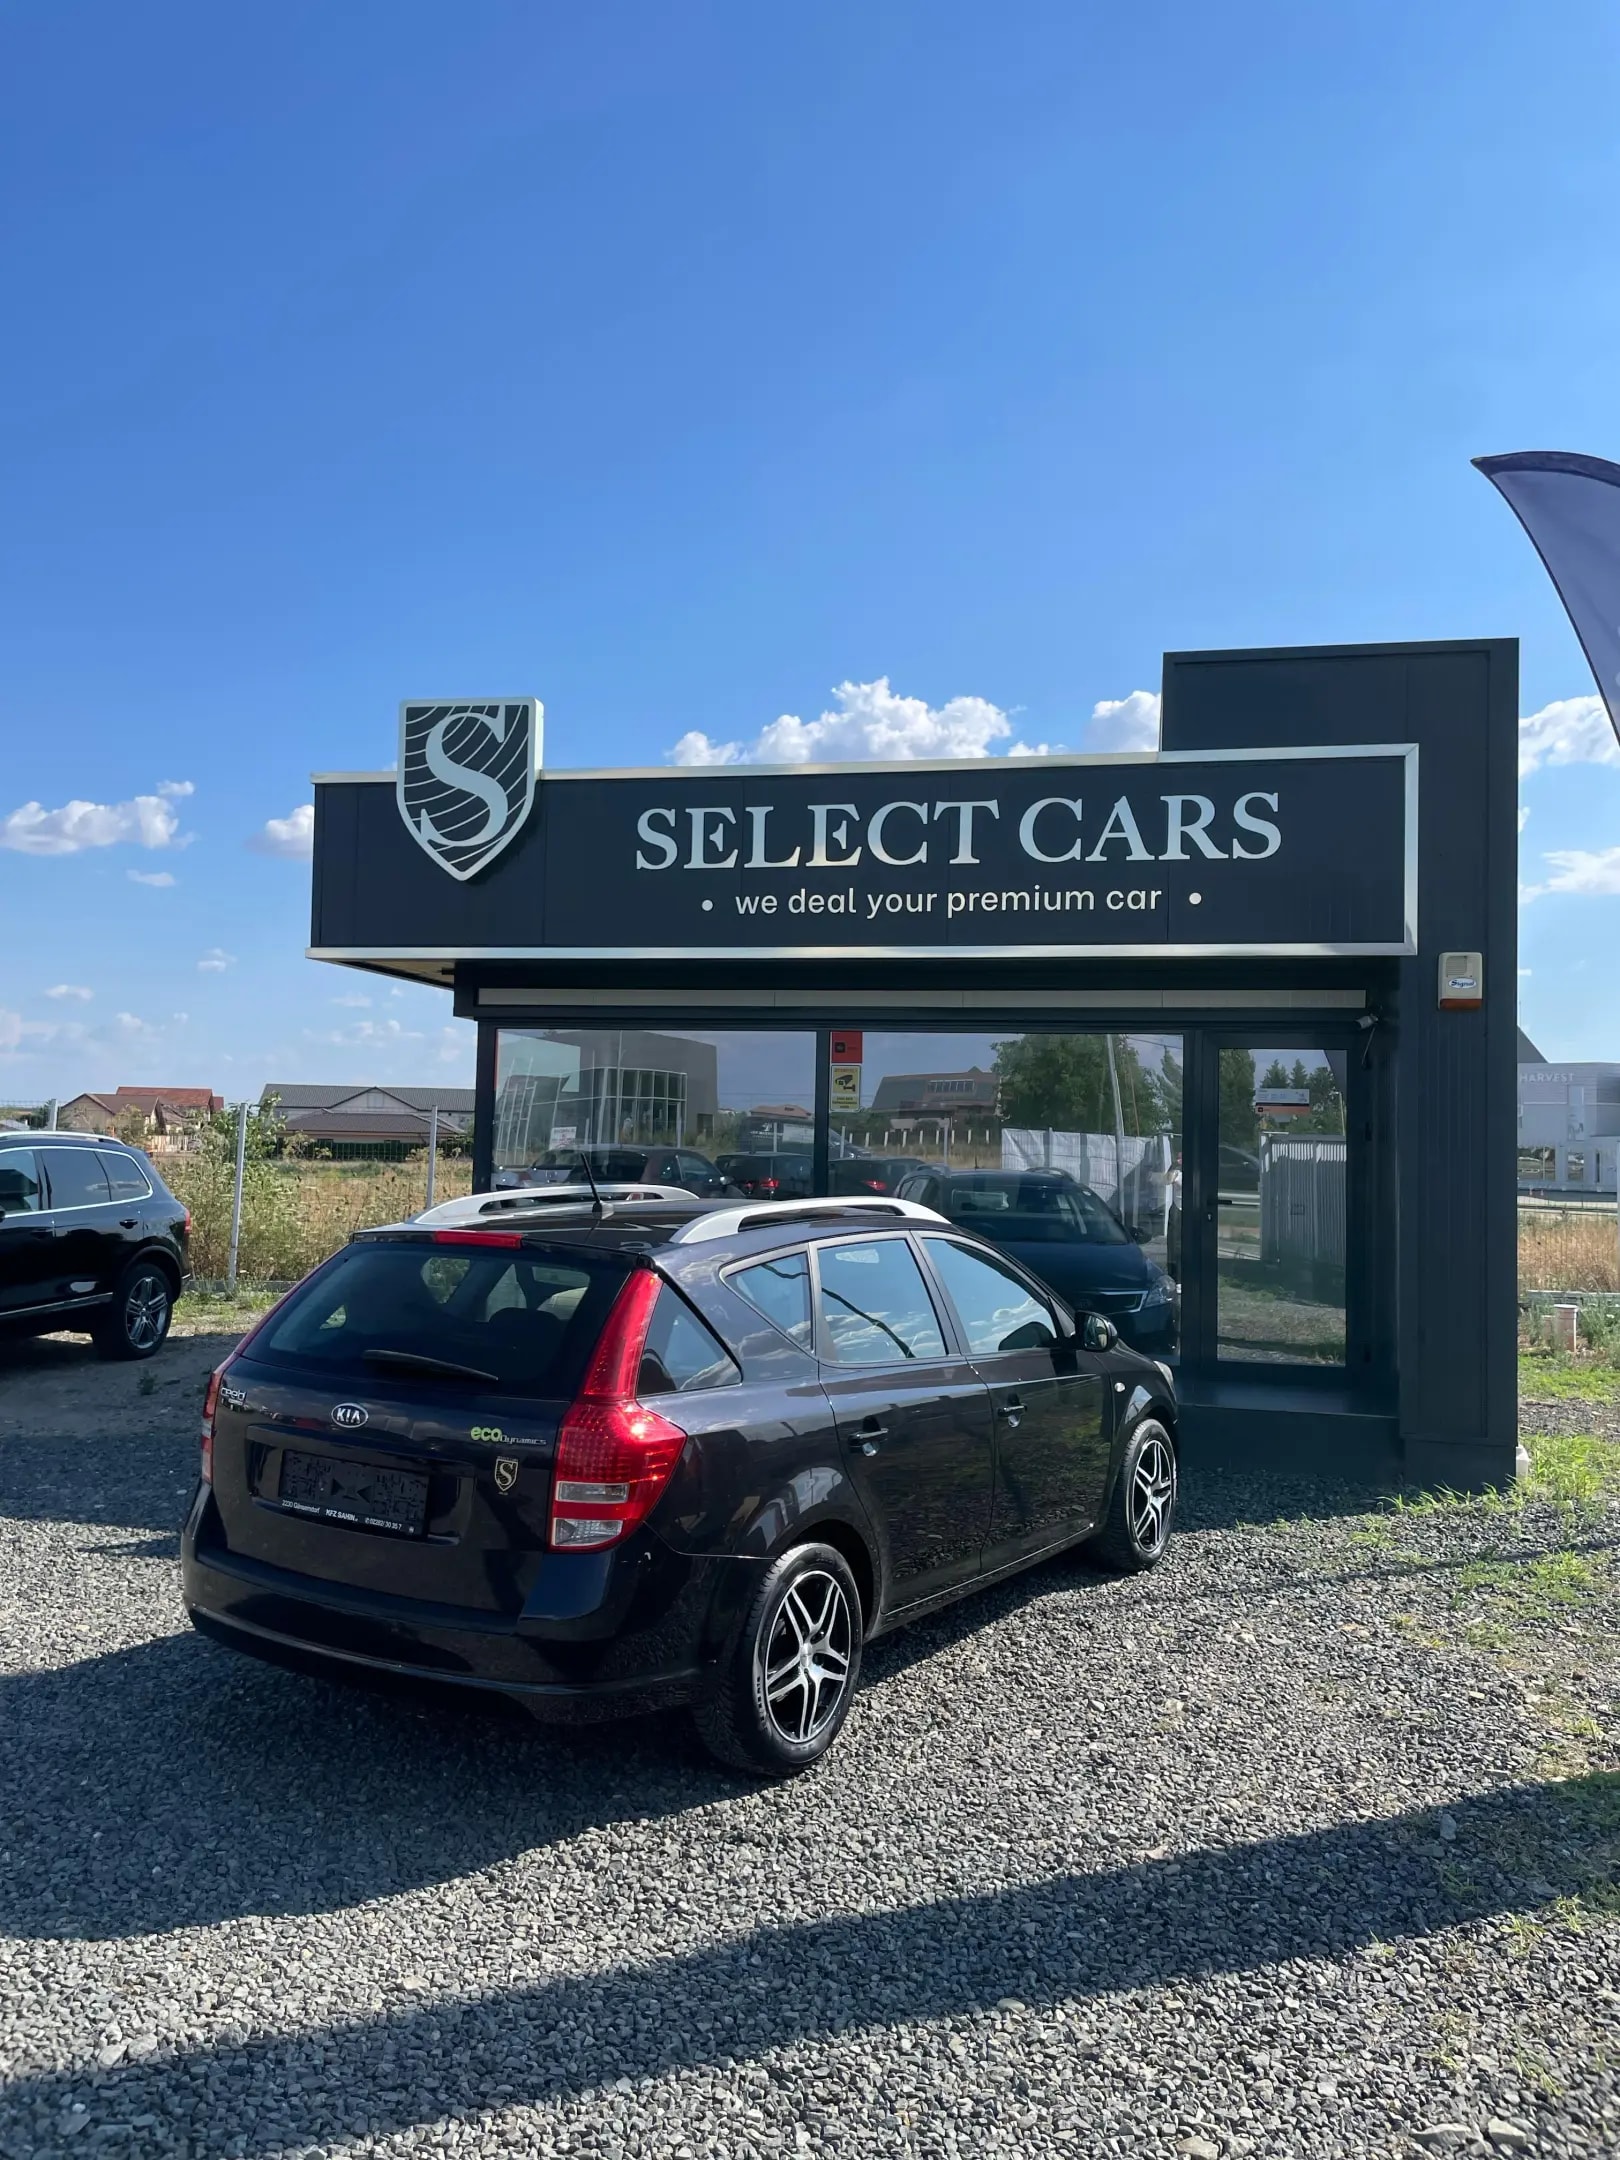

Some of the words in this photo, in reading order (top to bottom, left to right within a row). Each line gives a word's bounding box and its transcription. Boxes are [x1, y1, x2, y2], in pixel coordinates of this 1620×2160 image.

[636, 800, 1000, 870] SELECT
[1018, 791, 1282, 863] CARS
[736, 895, 778, 915] we
[788, 887, 857, 914] deal
[866, 893, 938, 920] your
[947, 884, 1095, 919] premium
[1106, 890, 1162, 911] car
[1519, 1072, 1575, 1083] HARVEST
[336, 1407, 361, 1424] KIA
